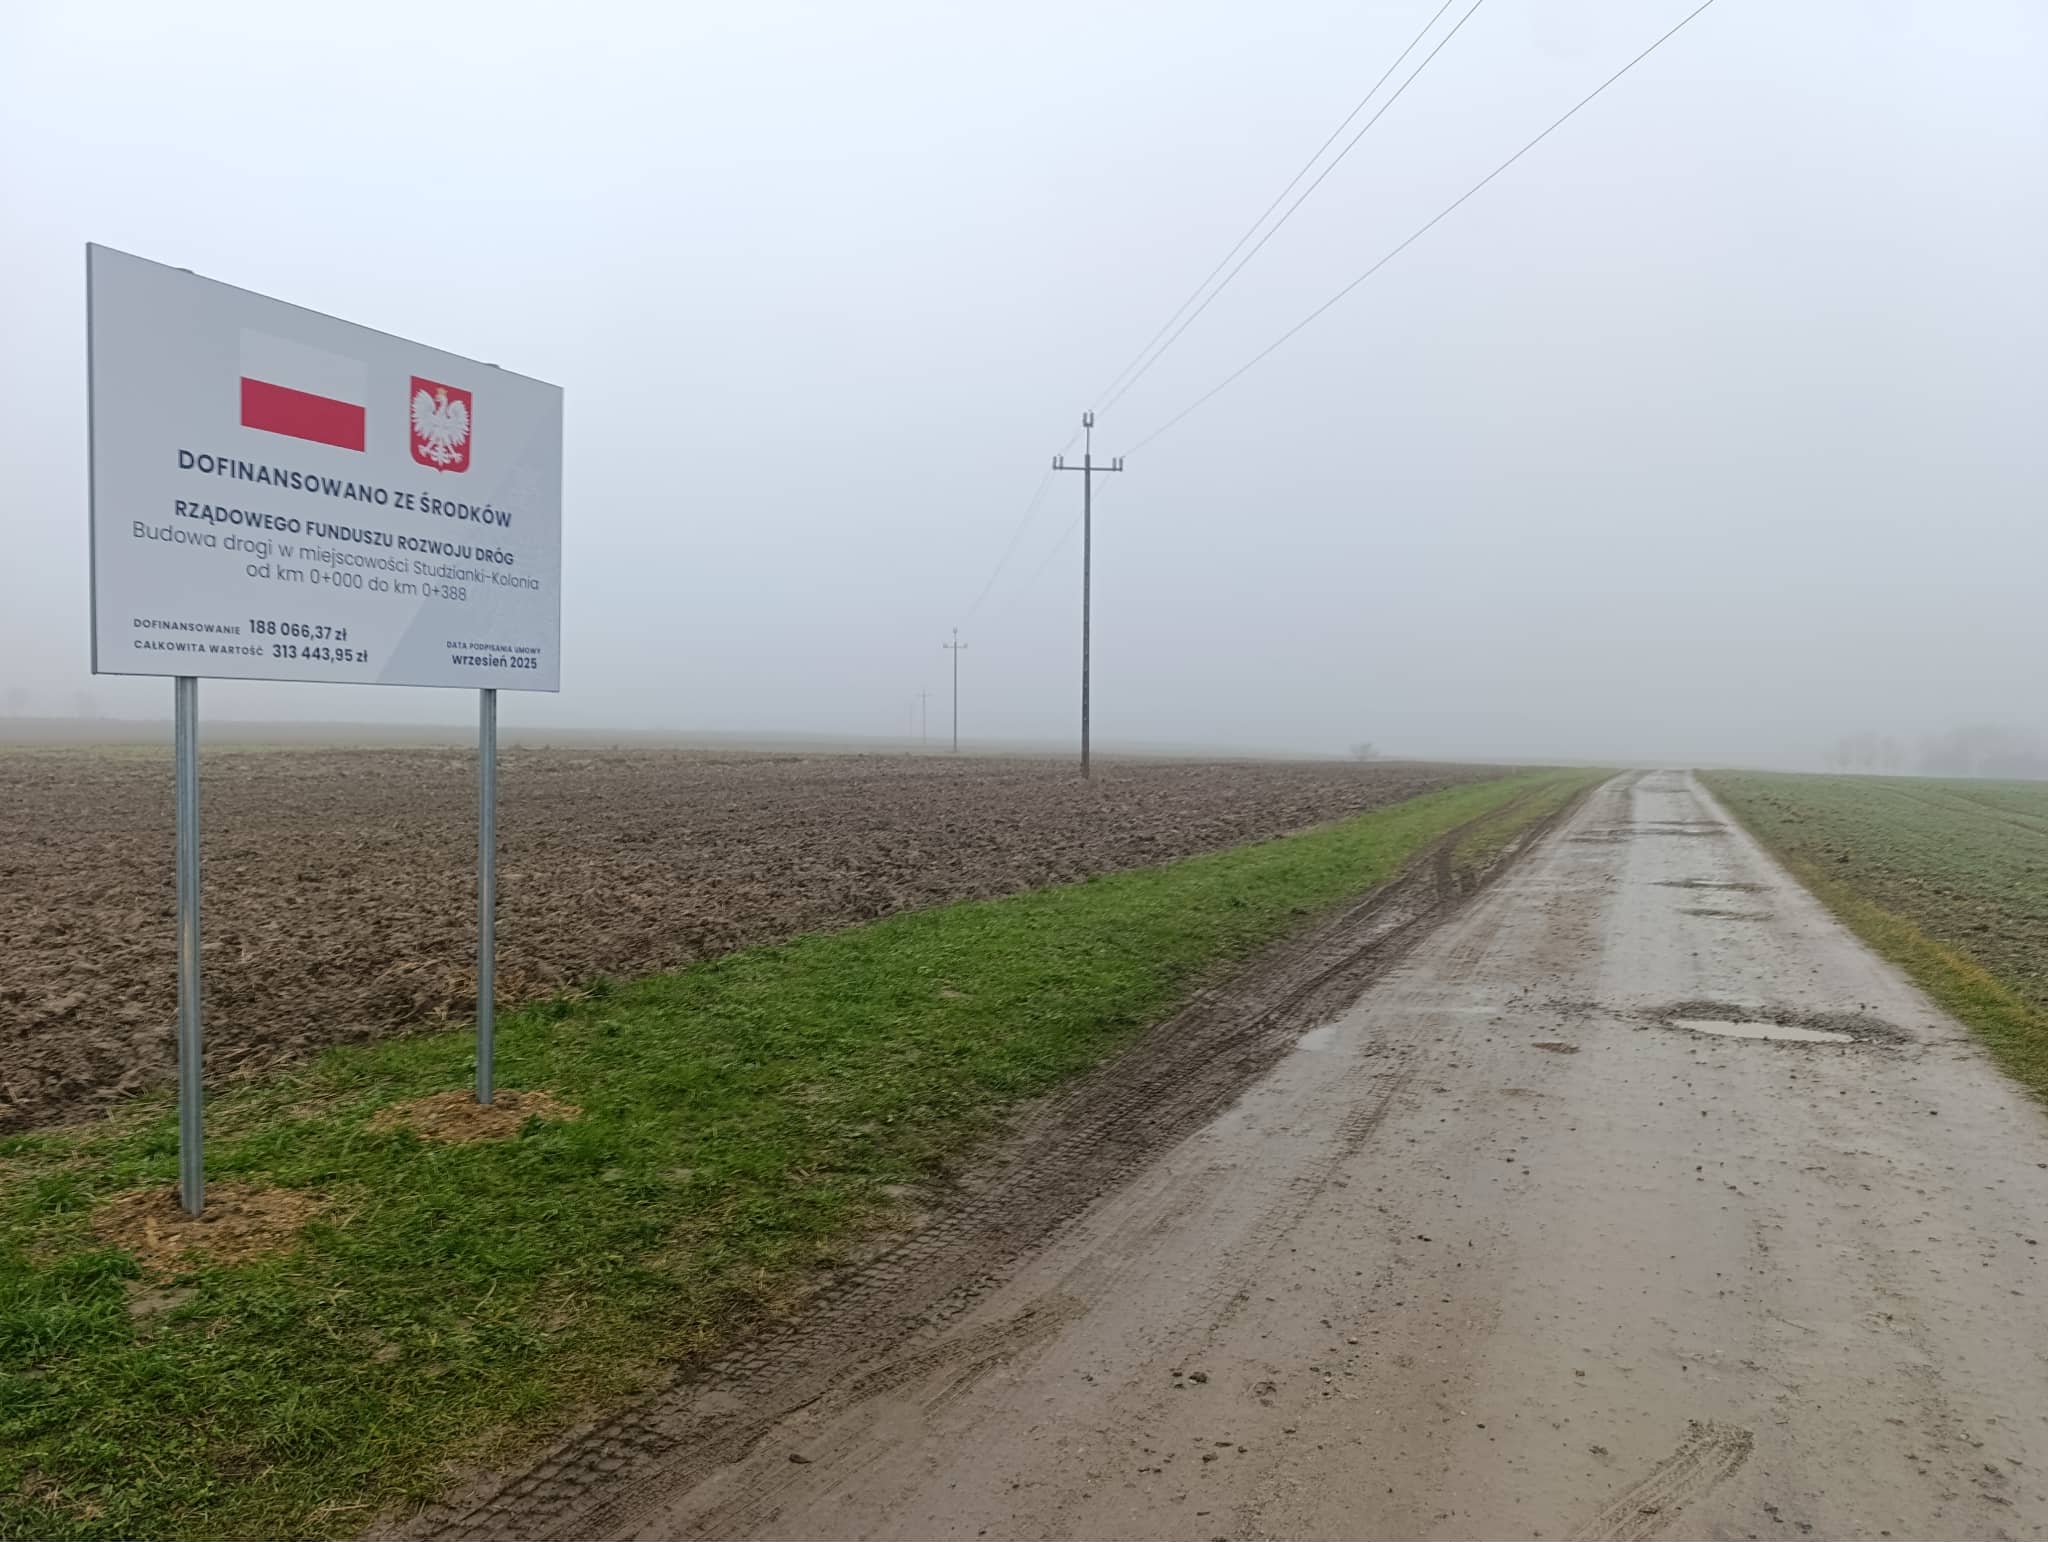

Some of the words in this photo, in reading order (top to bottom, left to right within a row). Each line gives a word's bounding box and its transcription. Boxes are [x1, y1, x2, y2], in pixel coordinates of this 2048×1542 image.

[178, 449, 389, 505] DOFINANSOWANO
[394, 492, 415, 510] ZE
[419, 492, 513, 528] ŚRODKÓW
[175, 500, 301, 533] RZĄDOWEGO
[306, 521, 393, 548] FUNDUSZU
[398, 536, 472, 559] ROZWOJU
[475, 547, 514, 566] DRÓG
[132, 520, 217, 548] Budowa
[223, 534, 273, 560] drogi
[278, 544, 293, 558] w
[299, 546, 409, 573] miejscowości
[413, 560, 539, 591] Studzianki-Kolonia
[246, 560, 271, 579] od
[276, 565, 304, 582] km
[310, 569, 362, 589] 0+000
[368, 575, 389, 592] do
[394, 578, 417, 595] km
[422, 582, 467, 602] 0+388
[134, 618, 240, 635] DOFINANSOWANIE
[249, 619, 276, 636] 188
[280, 622, 332, 641] 066,37
[335, 626, 347, 641] zł
[134, 639, 206, 653] CAŁKOWITA
[209, 644, 263, 656] WARTOŚĆ
[272, 644, 298, 659] 313
[301, 646, 353, 664] 443,95
[356, 649, 368, 663] zł
[447, 641, 466, 650] DATA
[469, 642, 512, 652] PODPISANIA
[513, 646, 541, 654] UMOWY
[452, 653, 507, 668] wrzesień
[510, 656, 537, 670] 2025
